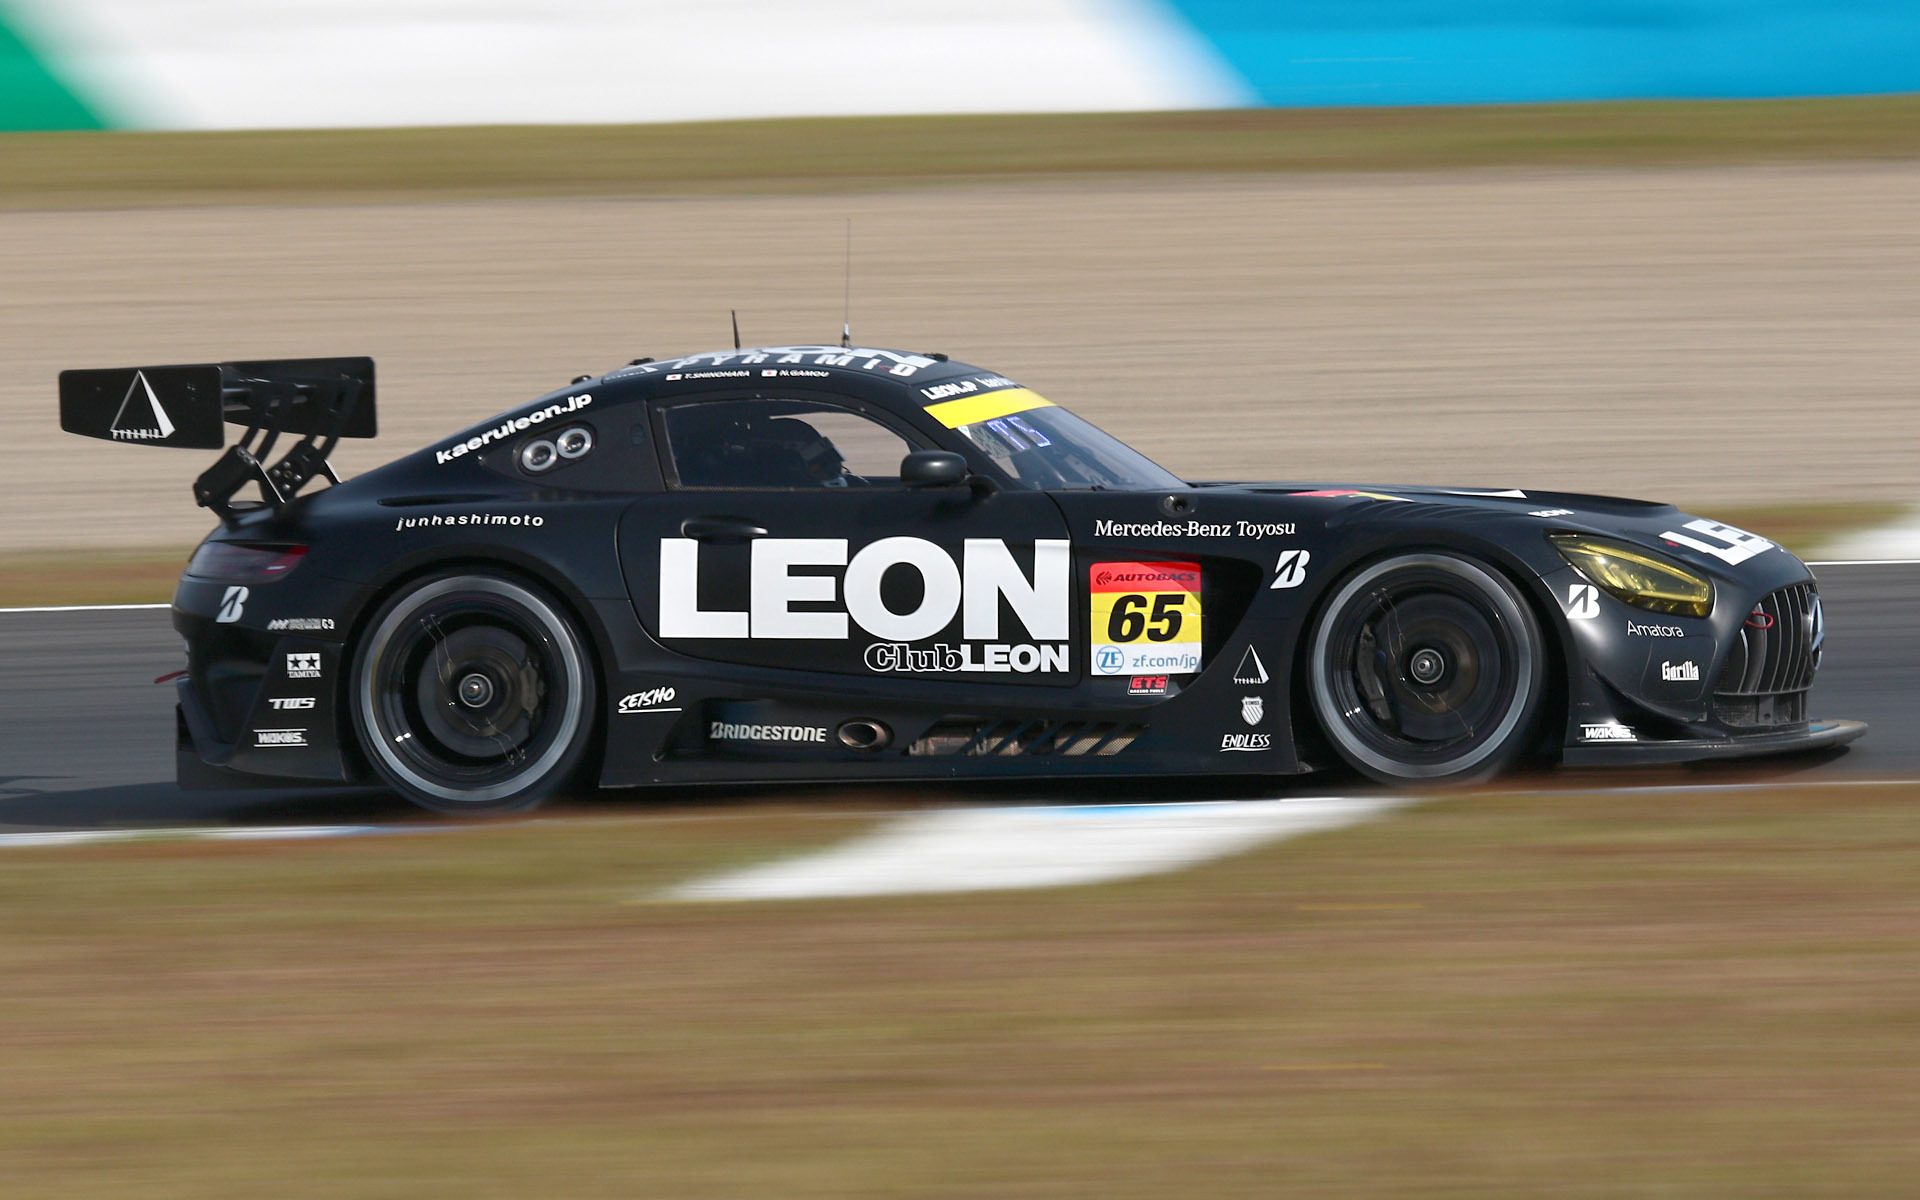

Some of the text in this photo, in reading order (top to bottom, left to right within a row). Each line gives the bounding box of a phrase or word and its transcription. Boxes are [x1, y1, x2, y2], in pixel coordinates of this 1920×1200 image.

[435, 393, 593, 465] kaeruleon.jp
[396, 513, 544, 532] junhashimoto
[1094, 519, 1296, 540] Mercedes-Benz Toyosu
[1113, 573, 1196, 582] AUTOBACS
[659, 536, 1070, 642] LEON
[1107, 594, 1186, 643] 65
[1627, 620, 1685, 639] Amatora
[1132, 654, 1198, 669] zf.com/jp
[1661, 660, 1700, 681] Gorilla
[1131, 676, 1167, 689] ETS
[268, 697, 317, 710] TWS
[618, 686, 676, 712] SEISHO
[710, 721, 827, 742] BRIDGESTONE
[1221, 734, 1271, 748] ENDLESS
